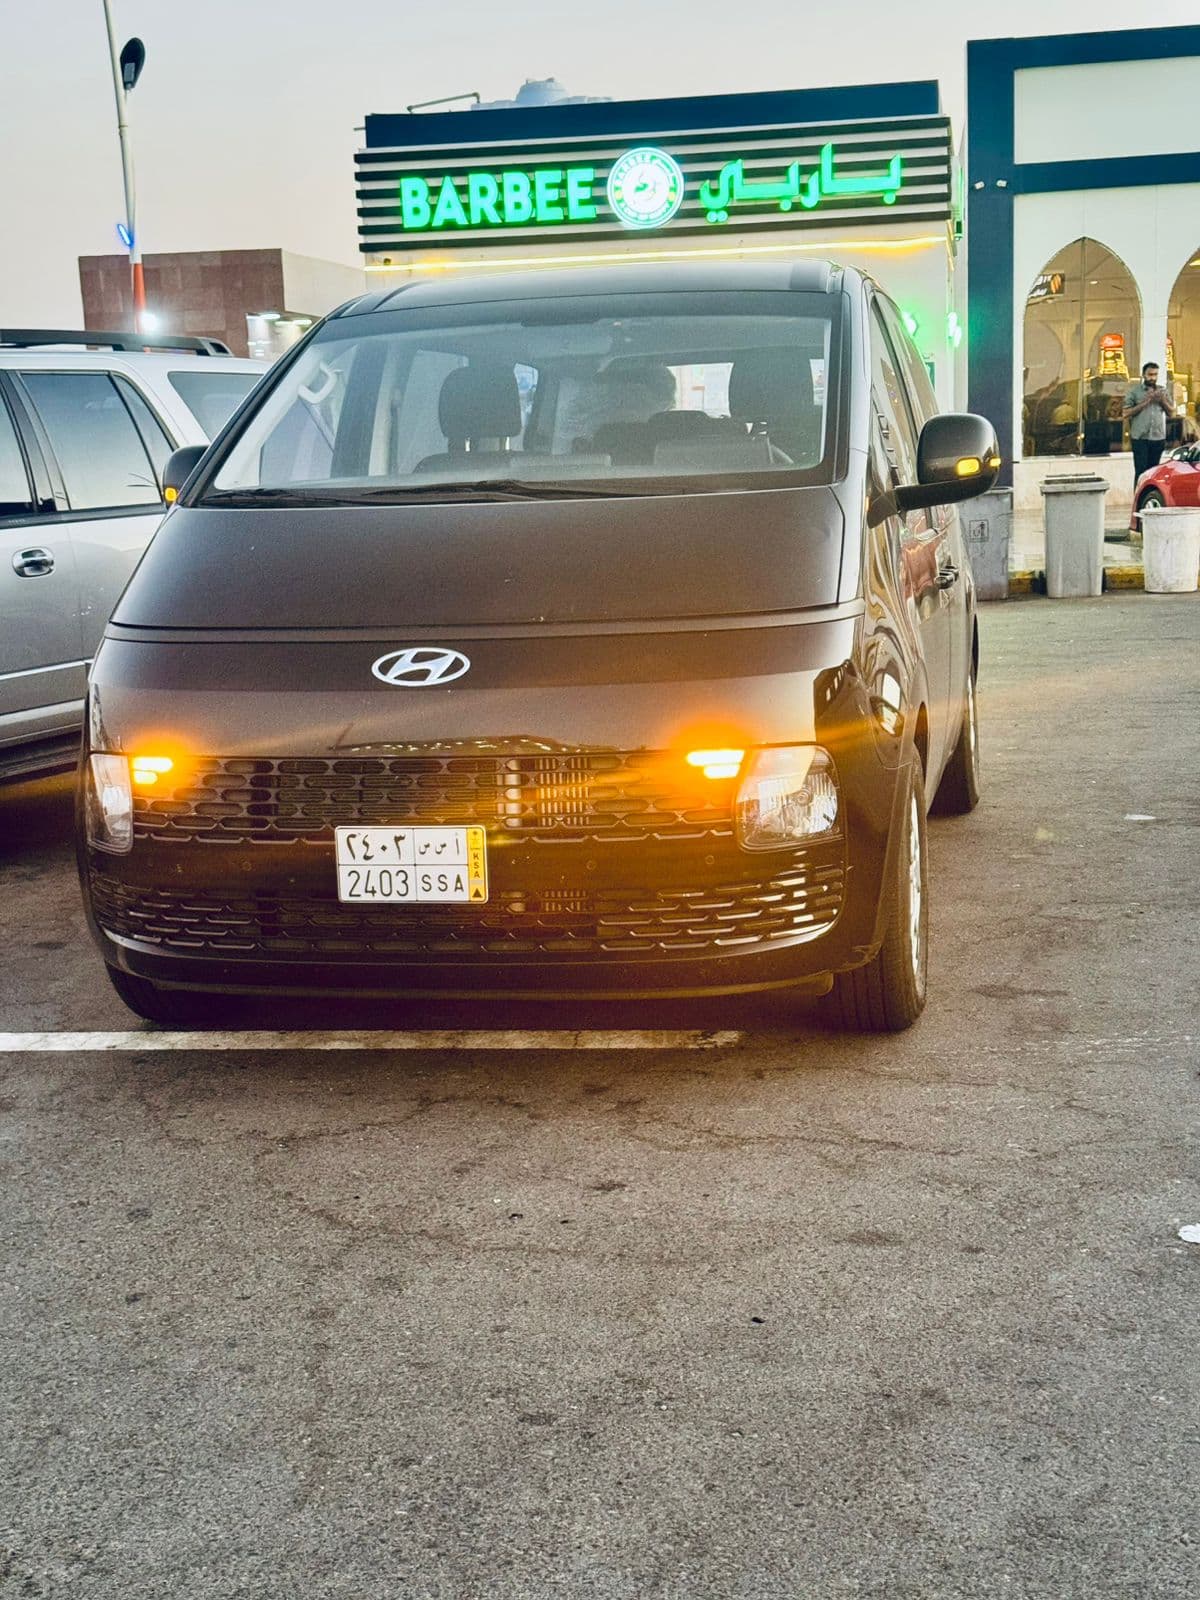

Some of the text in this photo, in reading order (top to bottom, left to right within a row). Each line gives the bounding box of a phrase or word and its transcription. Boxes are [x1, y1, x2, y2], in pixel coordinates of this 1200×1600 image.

[400, 168, 597, 229] BARBEE
[699, 141, 901, 222] باربي
[346, 833, 406, 861] ٢٤٠٣
[347, 869, 464, 898] 2403 SSA
